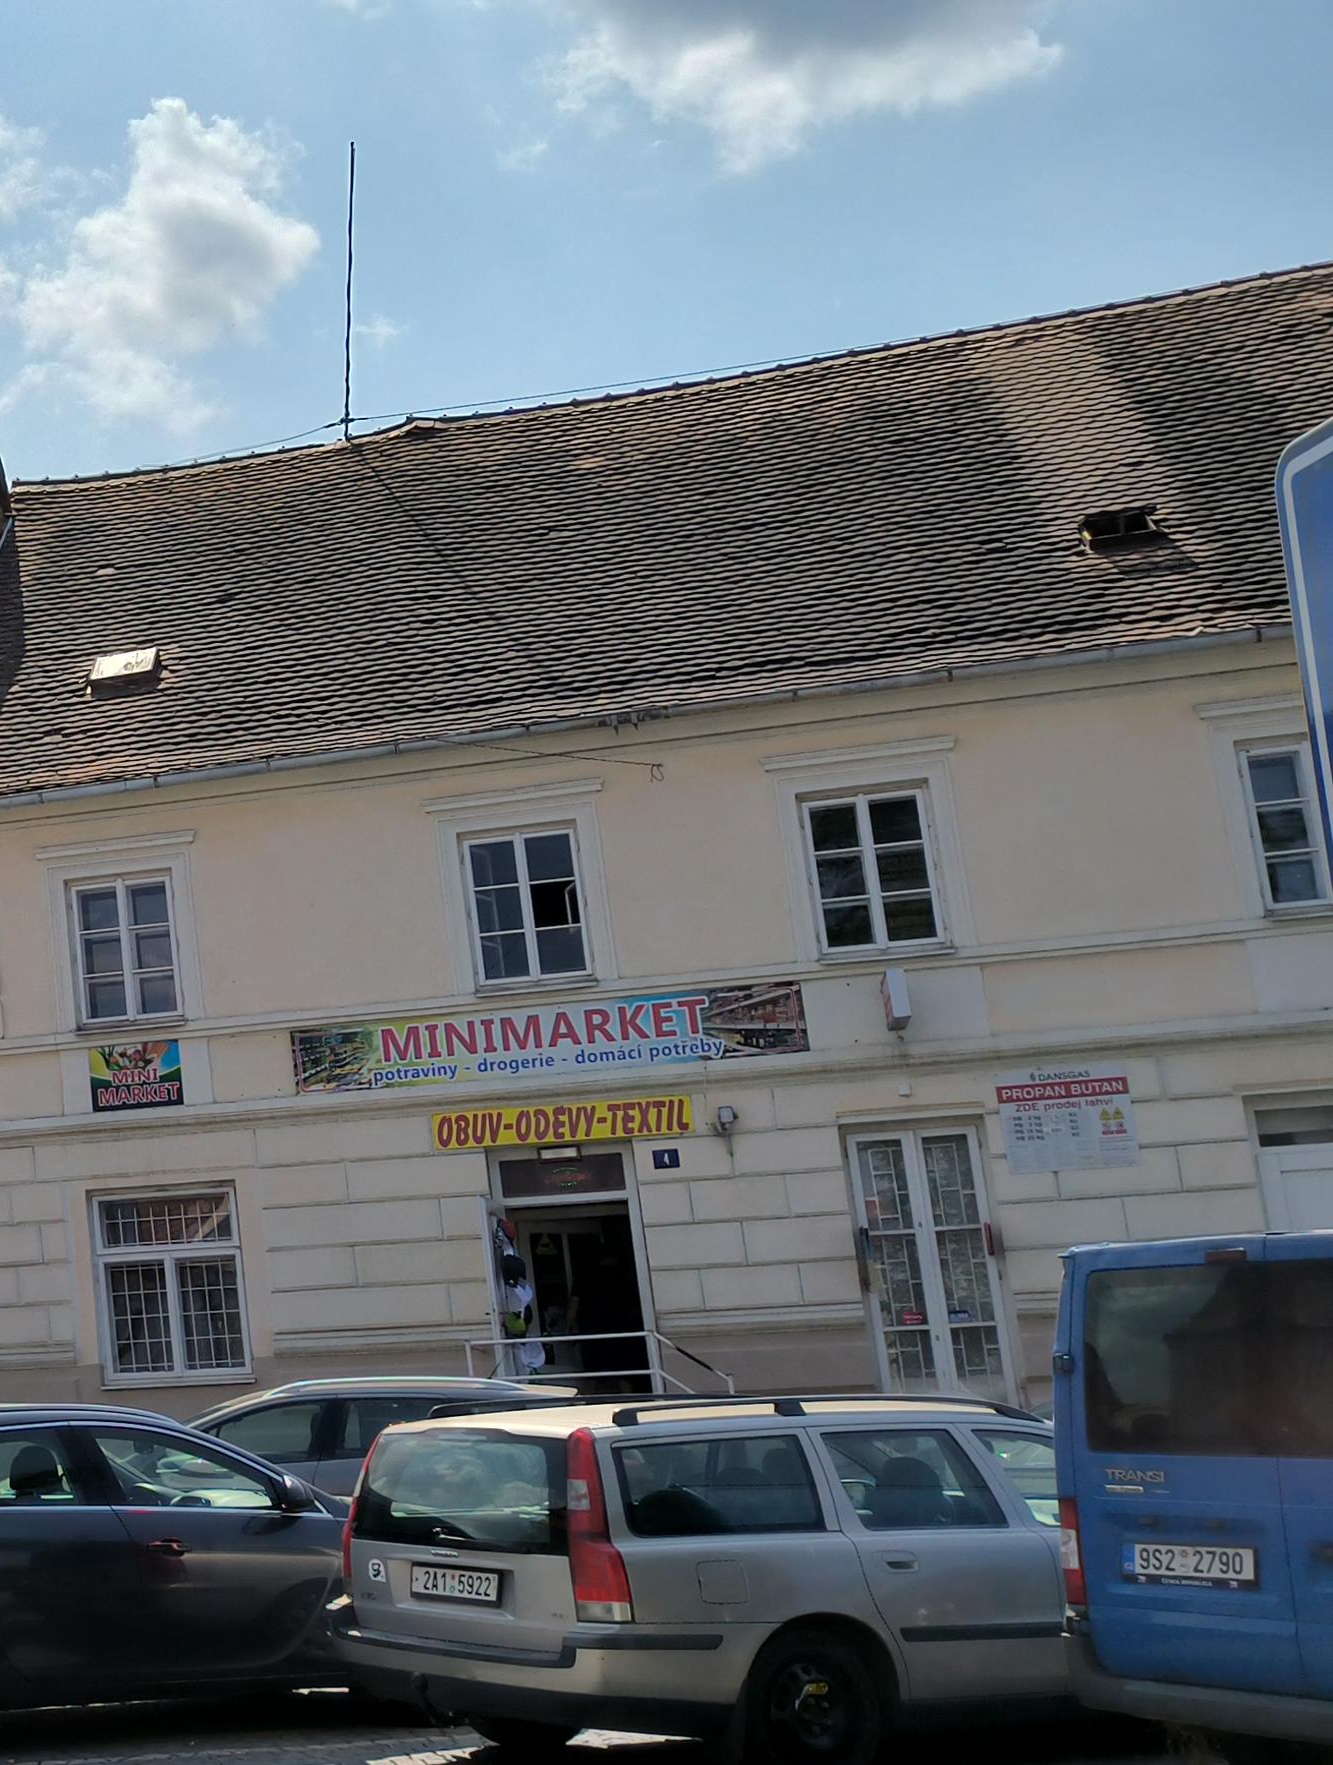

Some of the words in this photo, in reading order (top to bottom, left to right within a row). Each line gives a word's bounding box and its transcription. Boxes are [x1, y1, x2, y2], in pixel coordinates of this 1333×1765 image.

[379, 996, 709, 1065] MINIMARKET
[373, 1061, 458, 1087] potraviny
[477, 1051, 556, 1076] drogerie
[574, 1044, 643, 1065] domácí
[649, 1037, 726, 1065] potřeby
[112, 1068, 159, 1086] MINI
[1037, 1070, 1091, 1082] DANSGAS
[97, 1081, 180, 1107] MARKET
[1001, 1084, 1066, 1101] PROPAN
[1071, 1079, 1124, 1096] BUTAN
[1015, 1102, 1039, 1113] ZDE
[1044, 1099, 1082, 1113] prodej
[1139, 1547, 1176, 1571] 9S2
[1193, 1550, 1244, 1575] 2790
[423, 1570, 447, 1592] 2A1
[457, 1573, 492, 1597] 5922
